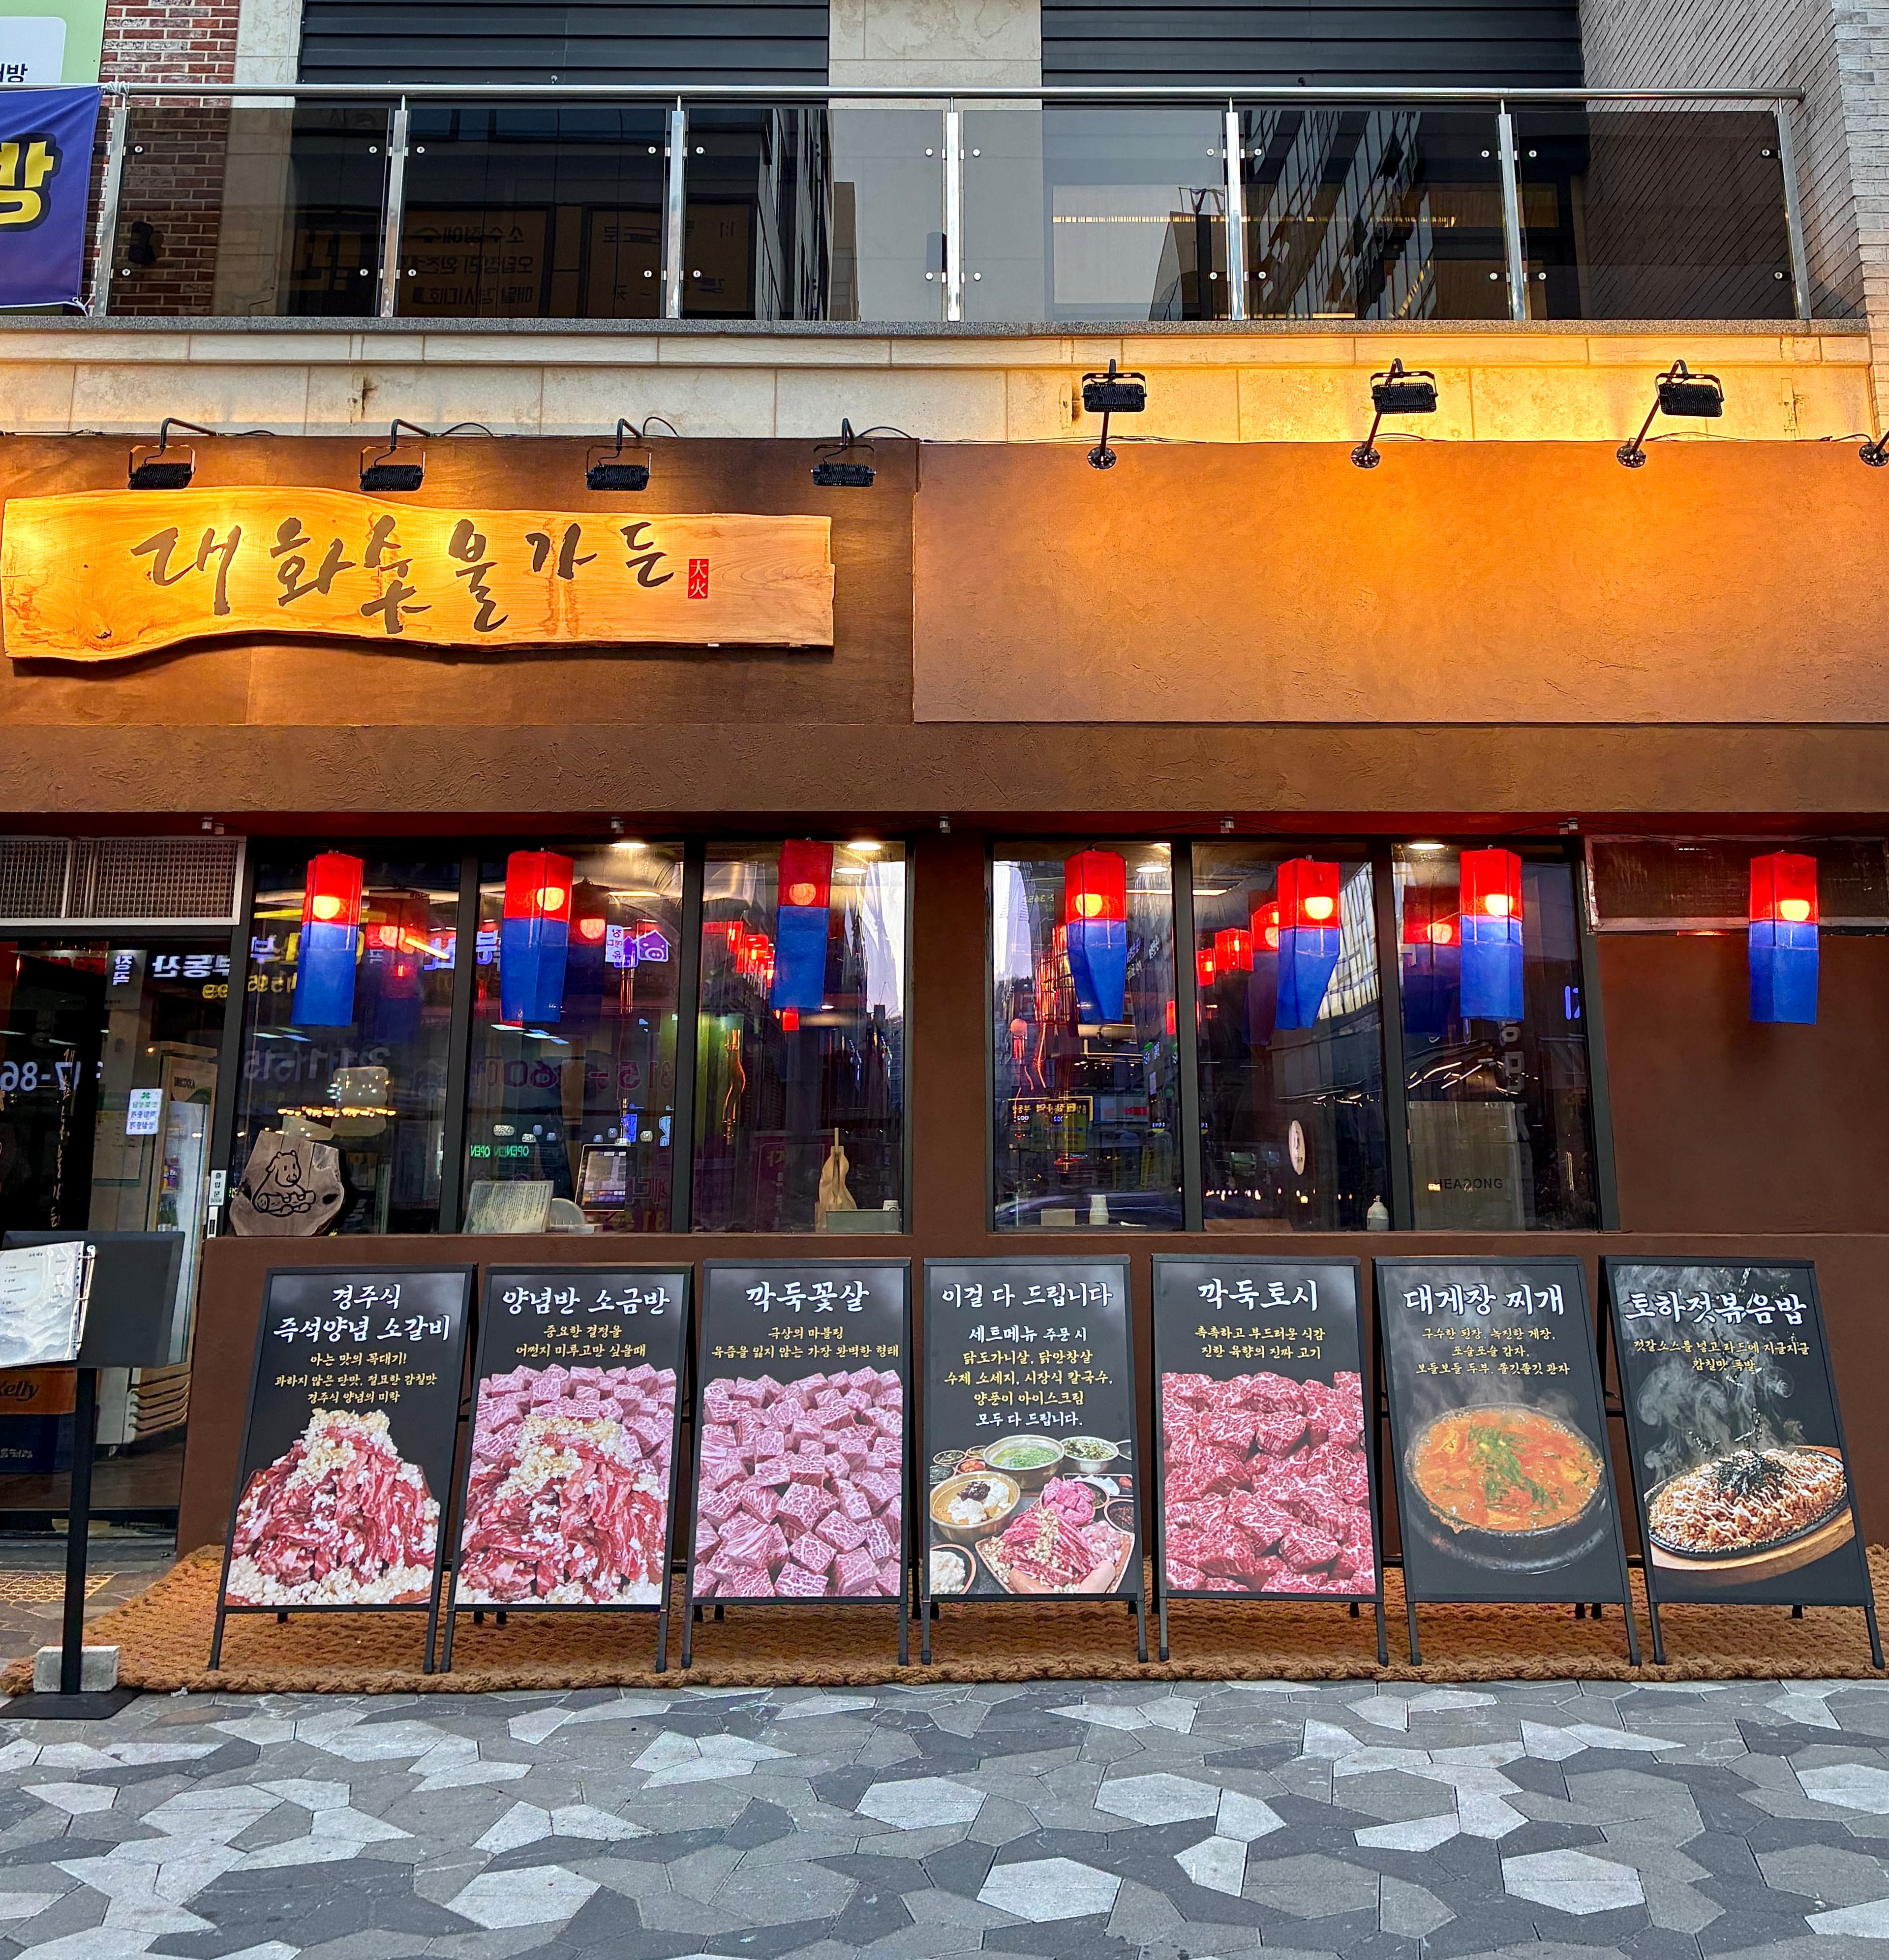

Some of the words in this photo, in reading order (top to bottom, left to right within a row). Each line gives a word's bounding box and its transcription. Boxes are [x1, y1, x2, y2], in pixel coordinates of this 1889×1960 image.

[0, 63, 28, 83] 방
[689, 560, 708, 598] 大火
[332, 1284, 401, 1310] 경주식
[502, 1286, 580, 1315] 양념반
[587, 1286, 670, 1315] 소금반
[746, 1281, 870, 1313] 깍둑꽃살
[942, 1284, 983, 1308] 이걸
[991, 1284, 1016, 1308] 다
[1022, 1283, 1114, 1307] 드립니다
[1197, 1278, 1319, 1311] 깍둑토시
[1403, 1283, 1497, 1316] 대게장
[1506, 1283, 1565, 1316] 찌개
[274, 1315, 369, 1343] 즉석양념
[376, 1315, 451, 1342] 소갈비
[543, 1324, 582, 1338] 중요한
[586, 1324, 622, 1338] 결정을
[768, 1326, 803, 1340] 극상의
[808, 1326, 844, 1340] 마블링
[968, 1324, 1038, 1344] 세트메뉴
[1042, 1327, 1070, 1342] 주문
[1074, 1327, 1087, 1342] 시
[1194, 1325, 1246, 1339] 촉촉하고
[1249, 1327, 1298, 1341] 부드러운
[1302, 1327, 1326, 1341] 식감
[1422, 1328, 1457, 1340] 구수한
[1490, 1327, 1524, 1341] 녹진한
[516, 1344, 551, 1358] 어쩐지
[555, 1344, 605, 1358] 미루고만
[609, 1344, 646, 1358] 싶을때
[711, 1346, 749, 1359] 육즙을
[753, 1346, 774, 1358] 잃지
[779, 1346, 803, 1358] 않는
[807, 1346, 832, 1358] 가장
[835, 1345, 872, 1358] 완벽한
[876, 1345, 899, 1358] 형태
[1201, 1345, 1225, 1358] 진한
[1229, 1345, 1265, 1359] 육향의
[1269, 1346, 1293, 1359] 진짜
[1297, 1346, 1321, 1360] 고기
[1452, 1346, 1498, 1357] 포슬포슬
[1697, 1340, 1720, 1353] 넣고
[1723, 1341, 1760, 1354] 라드에
[1763, 1341, 1810, 1355] 지글지글
[310, 1353, 335, 1367] 아는
[339, 1352, 363, 1366] 맛의
[366, 1351, 407, 1366] 꼭대기!
[1038, 1349, 1094, 1364] 닭안창살
[1416, 1362, 1463, 1375] 보들보들
[1498, 1362, 1544, 1376] 쫄깃쫄깃
[1546, 1362, 1570, 1376] 관자
[1692, 1358, 1728, 1372] 감칠맛
[1731, 1359, 1756, 1373] 폭발
[274, 1375, 308, 1387] 과하지
[311, 1374, 334, 1387] 않은
[367, 1373, 400, 1387] 절묘한
[404, 1373, 437, 1386] 감칠맛
[944, 1371, 971, 1386] 수제
[1024, 1371, 1063, 1385] 시장식
[307, 1391, 339, 1405] 경주식
[343, 1391, 374, 1404] 양념의
[378, 1390, 400, 1403] 미학
[974, 1391, 1014, 1406] 양푼이
[1018, 1390, 1084, 1406] 아이스크림
[975, 1413, 1004, 1427] 모두
[1007, 1412, 1022, 1427] 다
[1025, 1411, 1083, 1427] 드립니다.
